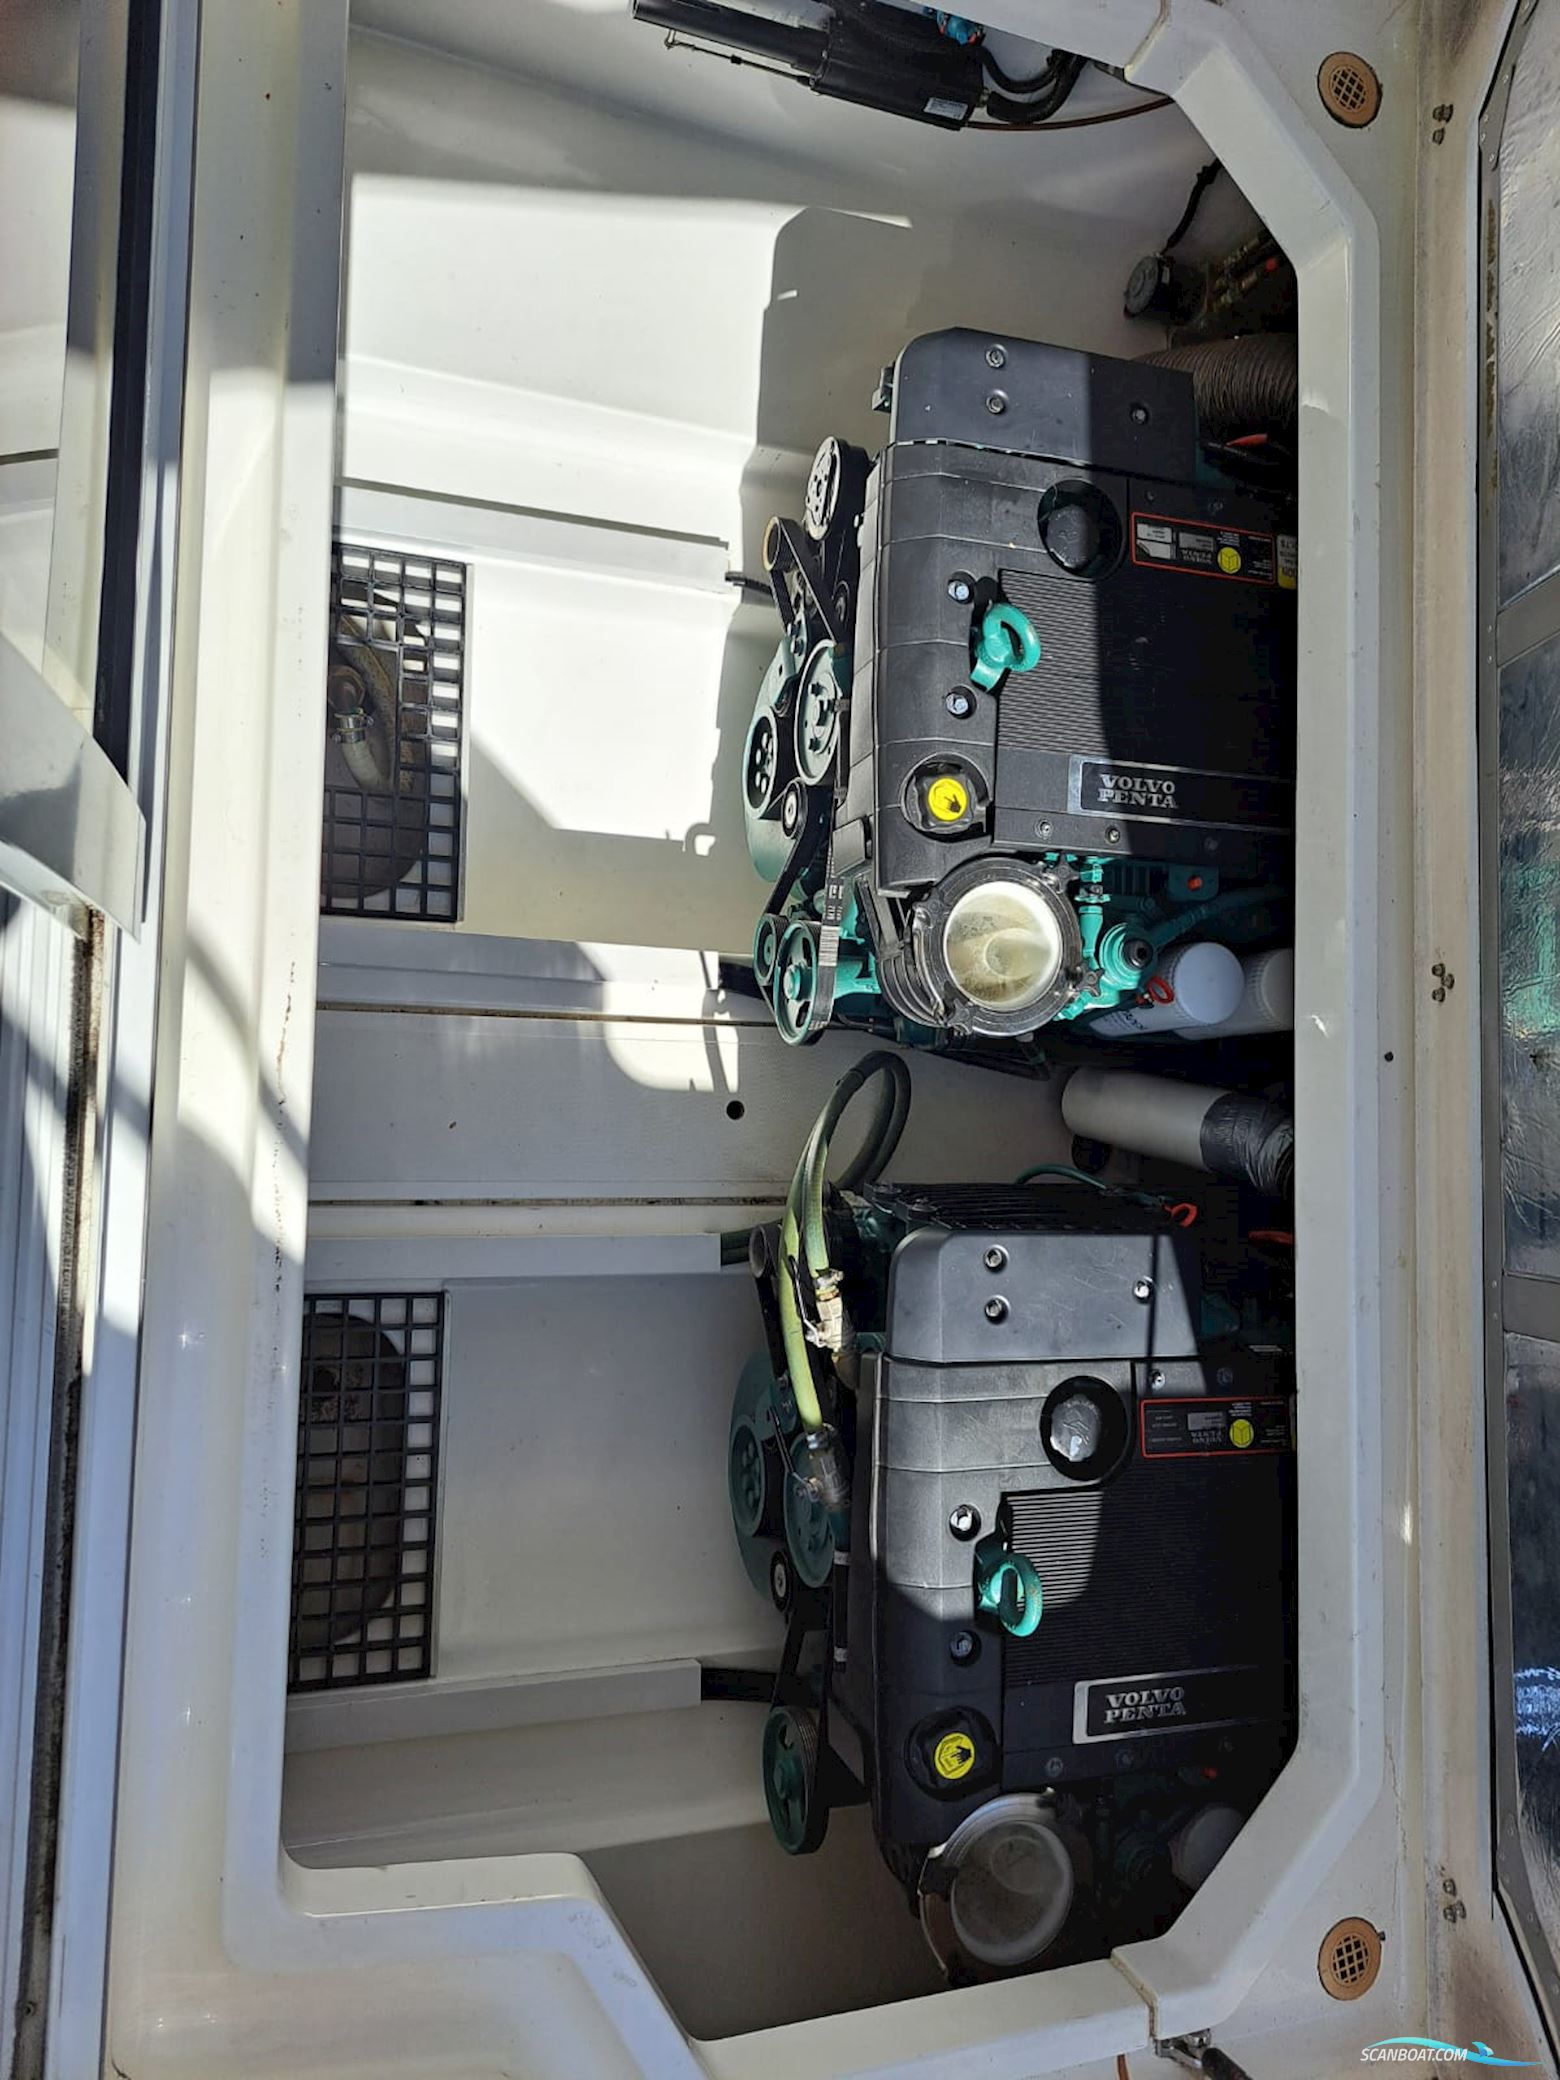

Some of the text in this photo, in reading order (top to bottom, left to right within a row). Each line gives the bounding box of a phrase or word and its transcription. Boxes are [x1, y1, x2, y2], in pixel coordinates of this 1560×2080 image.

[1099, 773, 1176, 794] VOLVO
[1097, 787, 1177, 809] PENTA
[1105, 1686, 1185, 1708] VOLVO
[1104, 1701, 1187, 1724] PENTA
